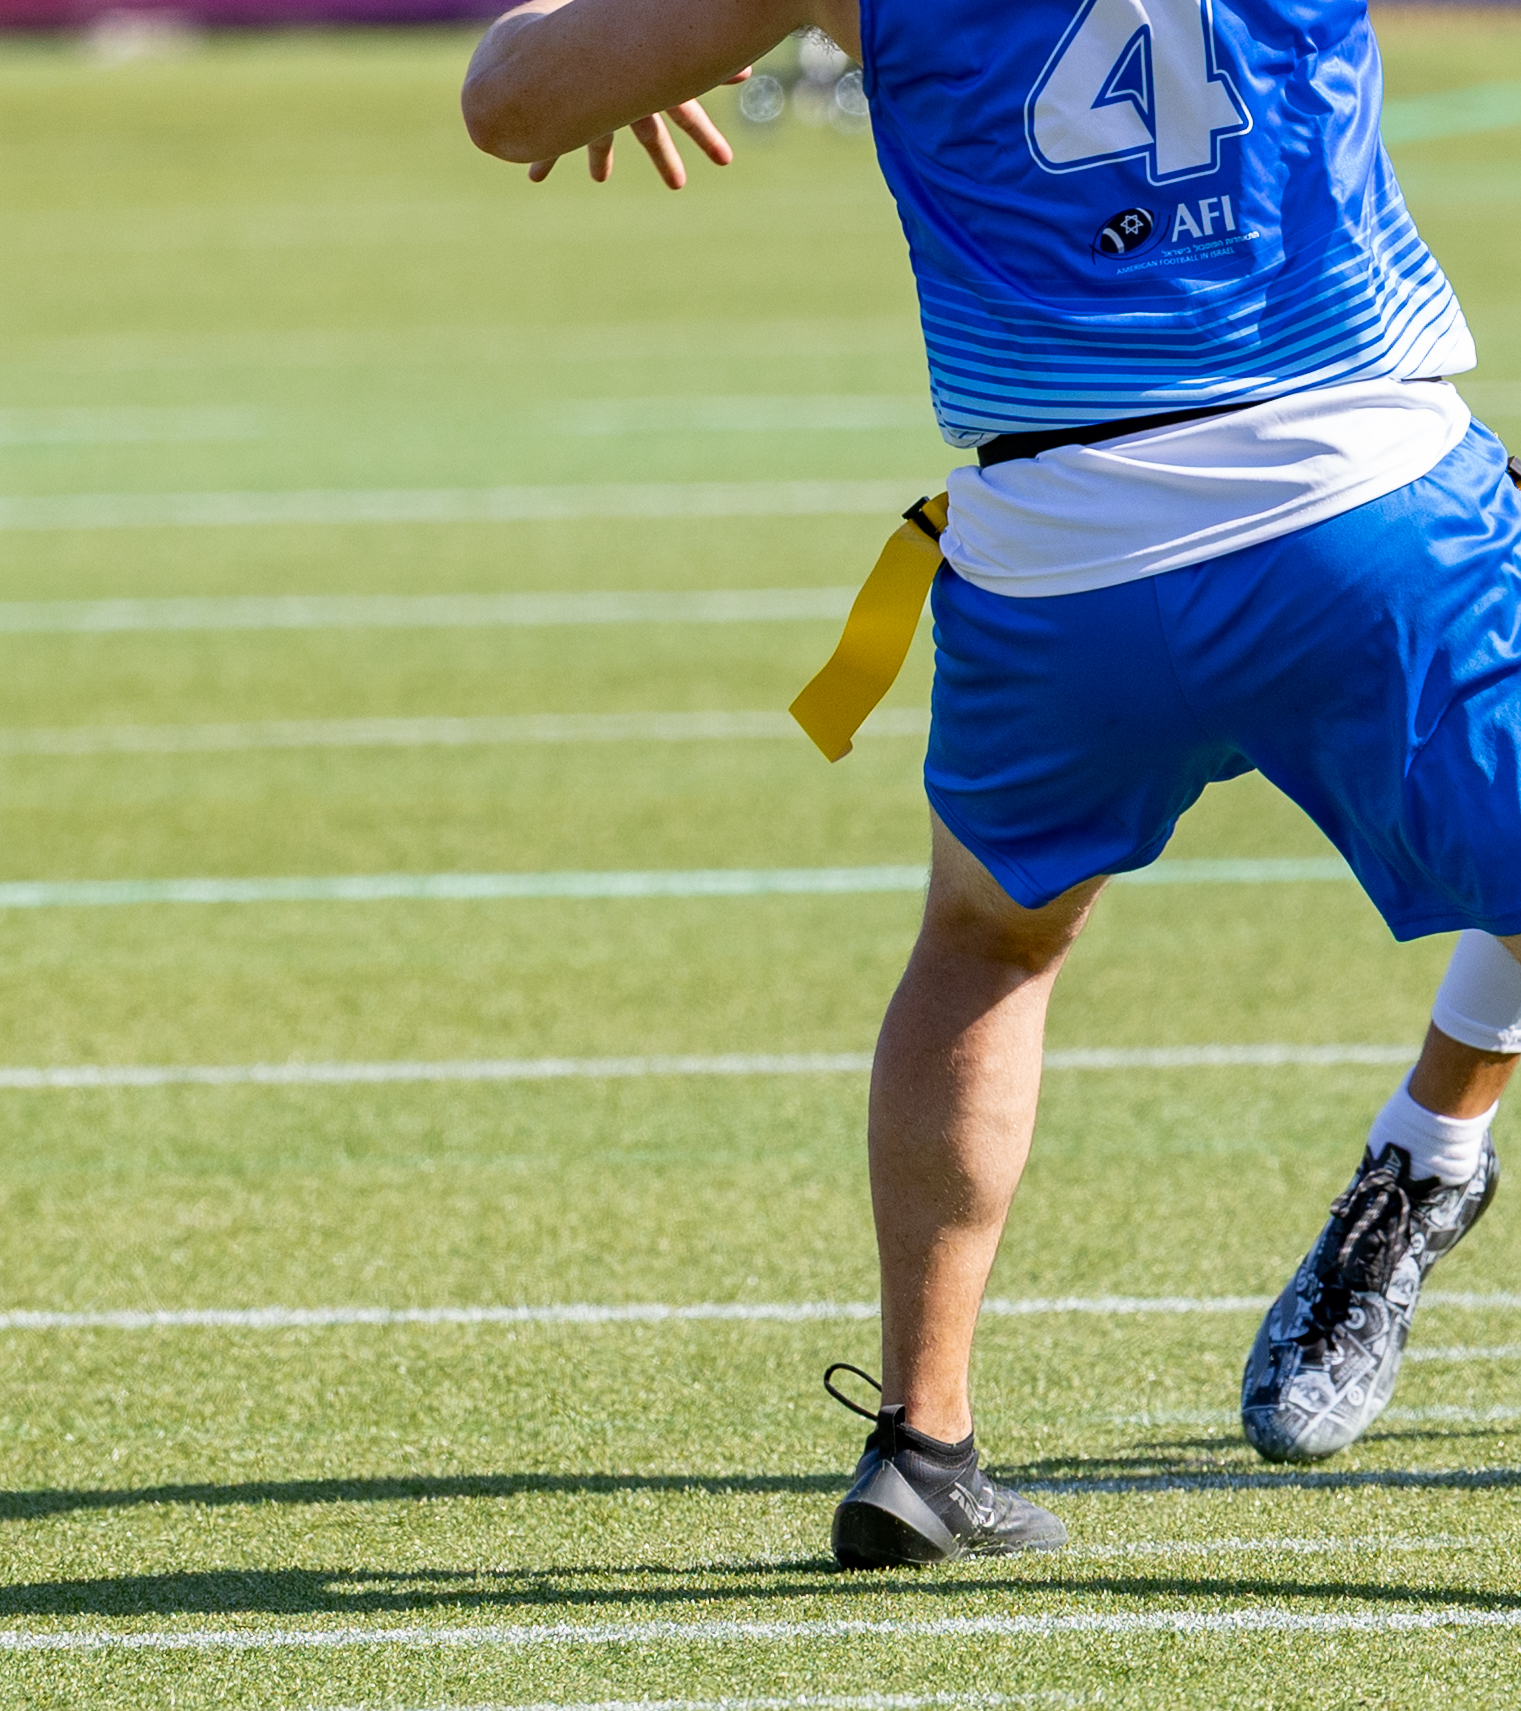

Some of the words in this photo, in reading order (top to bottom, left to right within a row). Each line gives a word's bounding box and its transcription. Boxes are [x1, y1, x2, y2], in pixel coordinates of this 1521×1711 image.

[1171, 194, 1236, 243] AFI
[1116, 260, 1158, 276] AMERICAN
[1159, 253, 1199, 267] FOOTBALL
[1200, 252, 1209, 260] IN
[1210, 246, 1235, 259] ISRAEL
